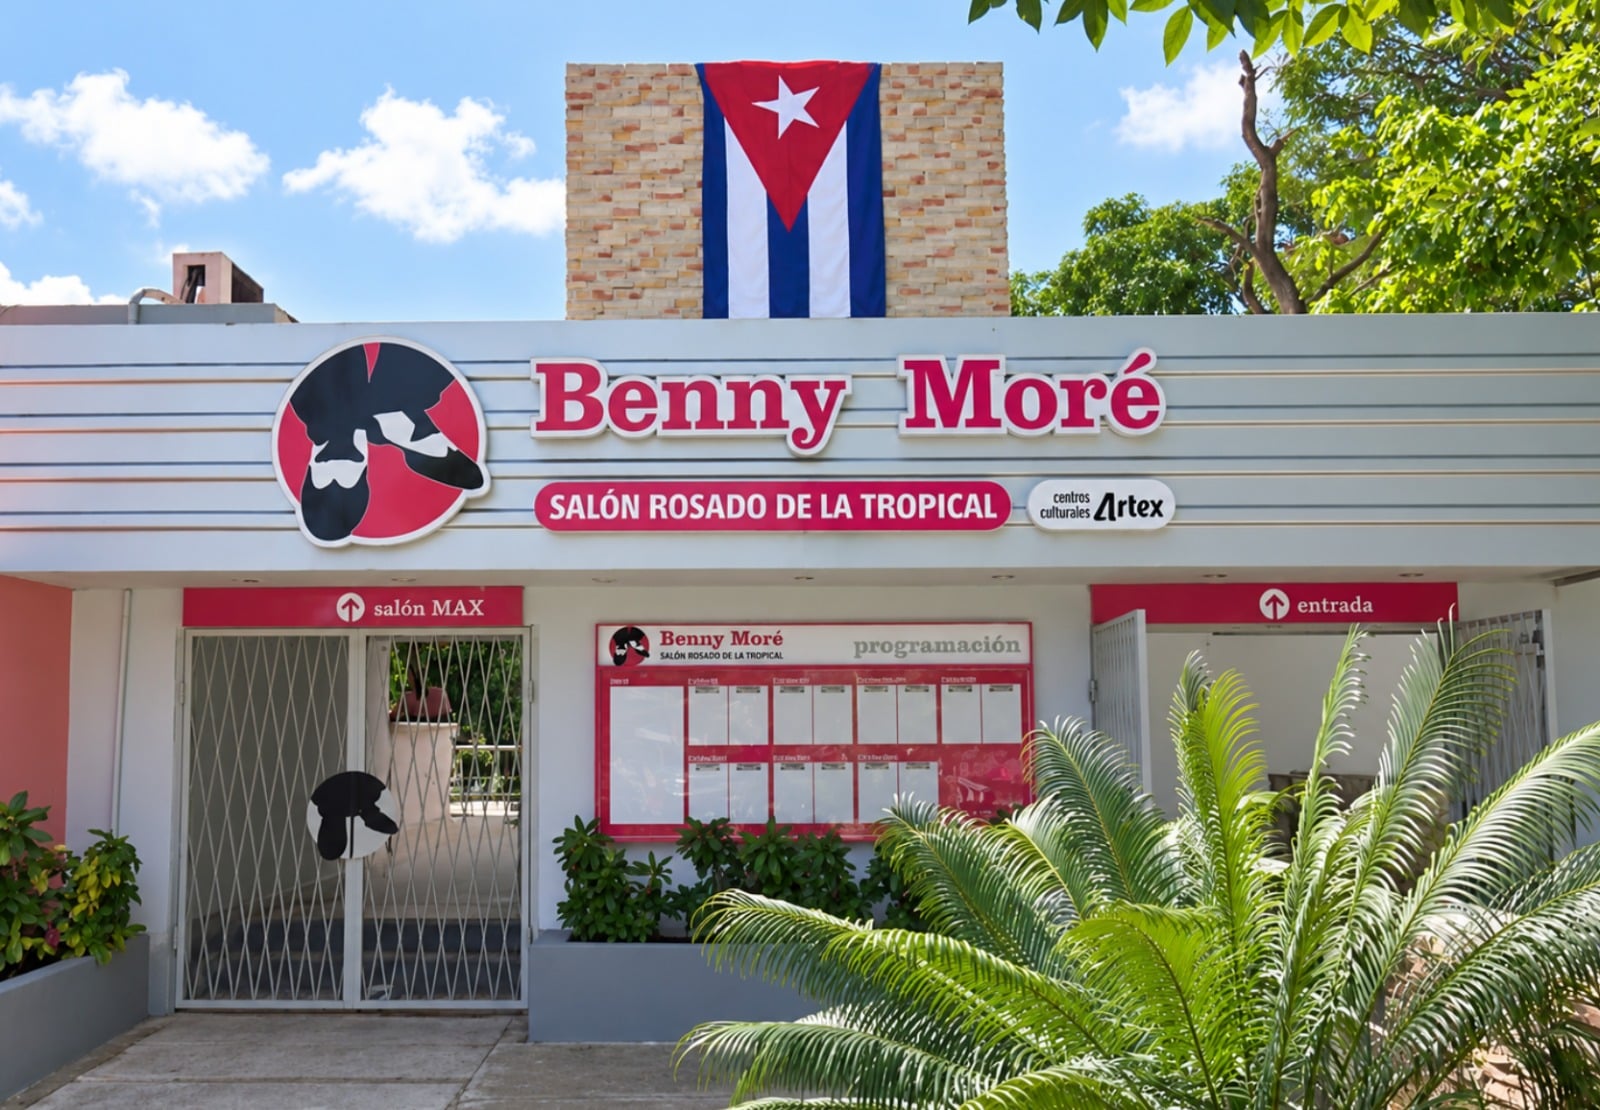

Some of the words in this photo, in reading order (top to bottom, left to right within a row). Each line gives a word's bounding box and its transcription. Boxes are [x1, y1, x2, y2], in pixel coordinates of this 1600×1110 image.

[535, 362, 846, 449] Benny
[903, 351, 1160, 430] Moré
[549, 488, 640, 520] SALÓN
[650, 493, 767, 520] ROSADO
[776, 493, 812, 519] DE
[820, 493, 853, 519] LA
[860, 492, 998, 519] TROPICAL
[1053, 491, 1091, 504] centros
[1093, 491, 1164, 522] Artex
[1040, 505, 1091, 519] culturales
[373, 599, 426, 616] salón
[431, 599, 485, 616] MAX
[1297, 596, 1374, 614] entrada
[659, 630, 725, 650] Benny
[730, 630, 784, 646] Moré
[853, 635, 1021, 659] programación
[660, 651, 686, 660] SALÓN
[688, 651, 721, 660] ROSADO
[722, 652, 732, 660] DE
[734, 652, 744, 660] LA
[746, 651, 784, 660] TROPICAL
